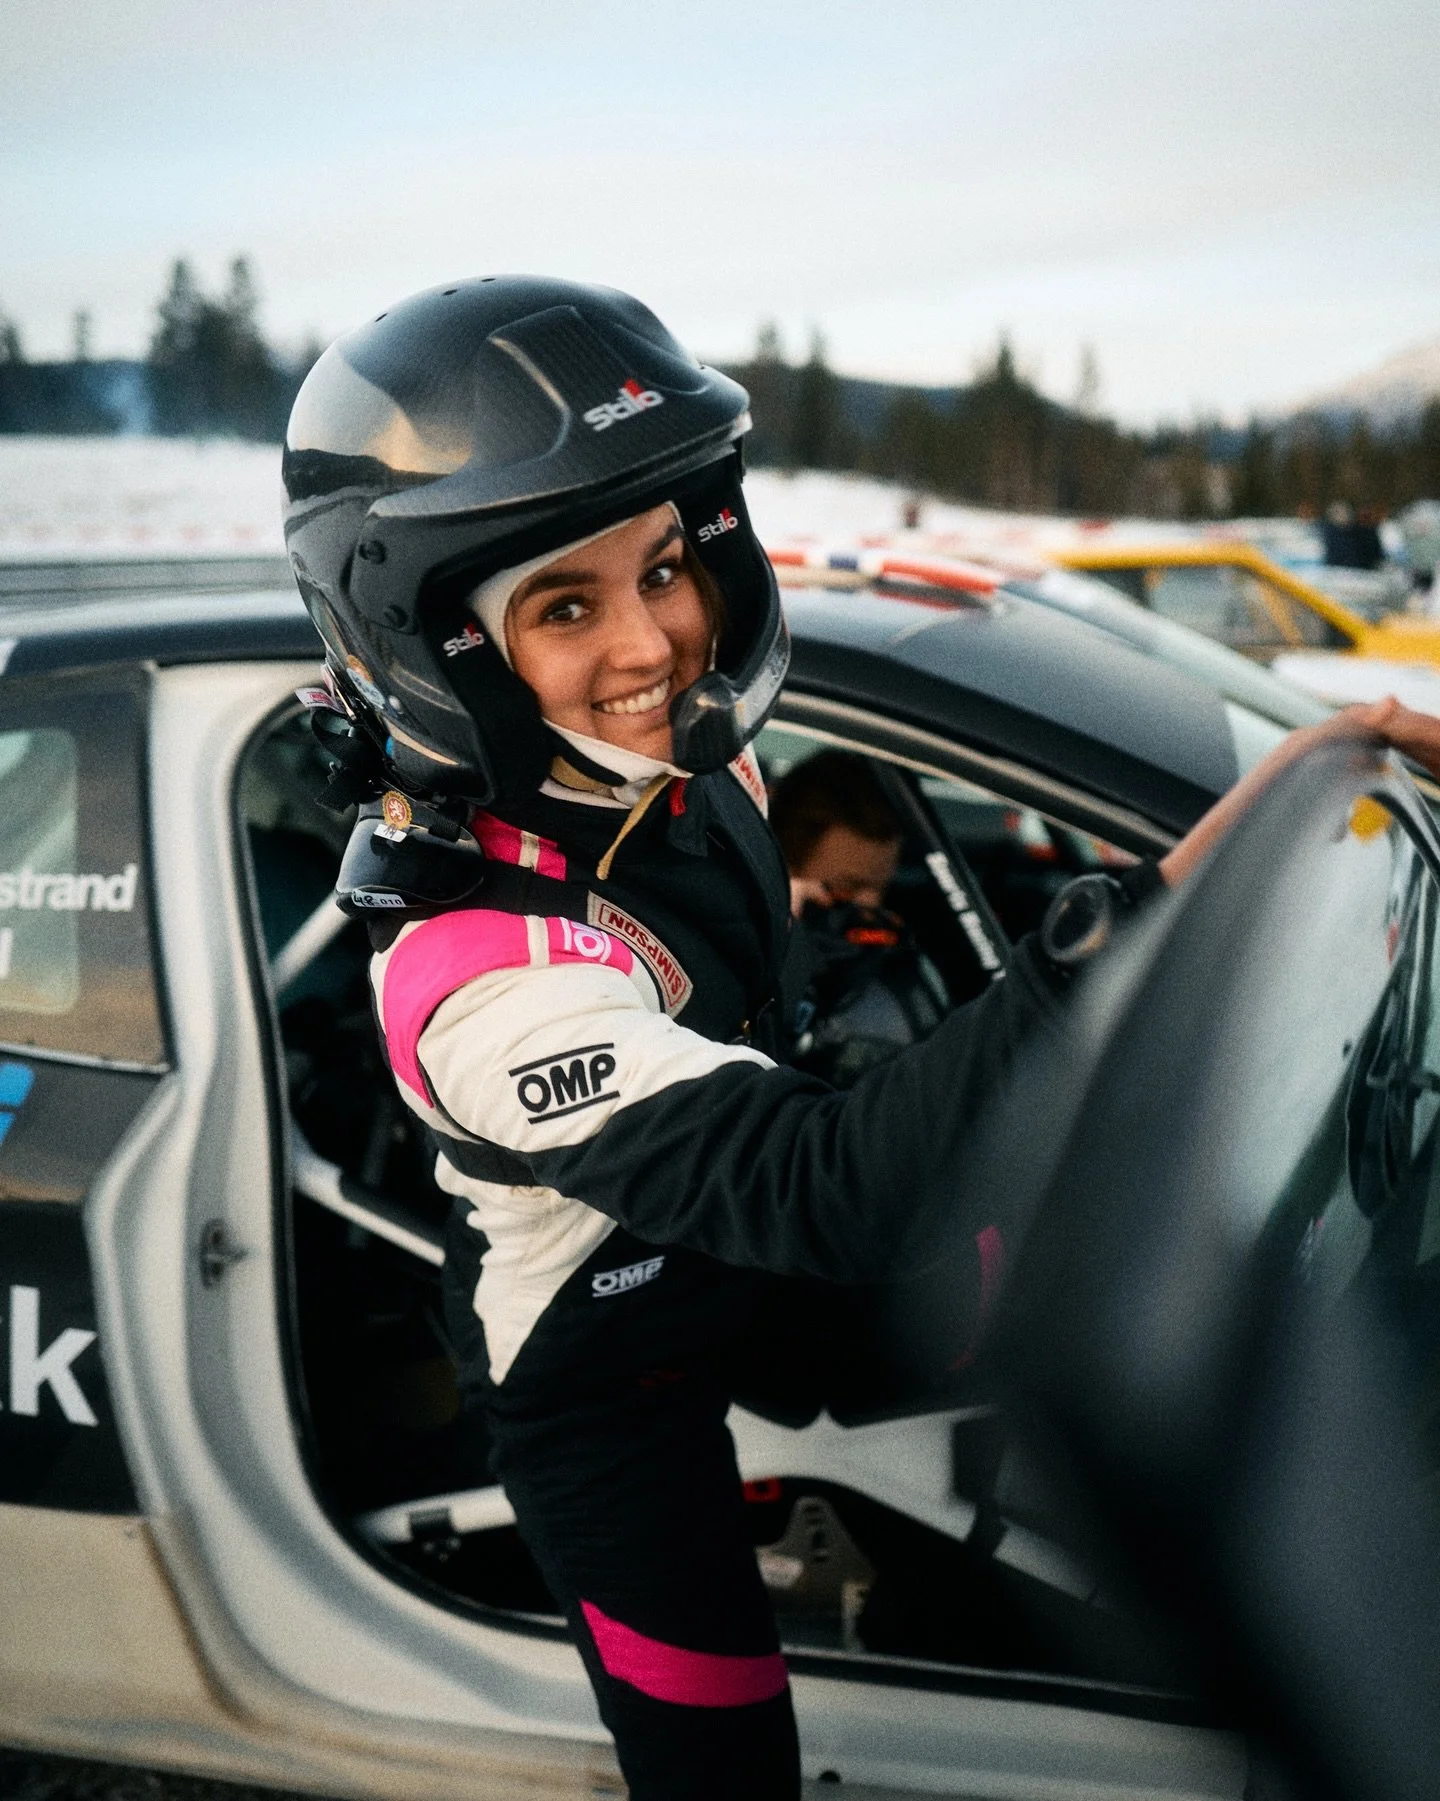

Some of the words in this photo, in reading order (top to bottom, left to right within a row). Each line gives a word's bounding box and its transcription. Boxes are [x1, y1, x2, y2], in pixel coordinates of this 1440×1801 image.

[608, 911, 682, 995] SIMPSON
[517, 1053, 616, 1113] OMP
[591, 1260, 664, 1294] OMP
[0, 1284, 99, 1427] k
